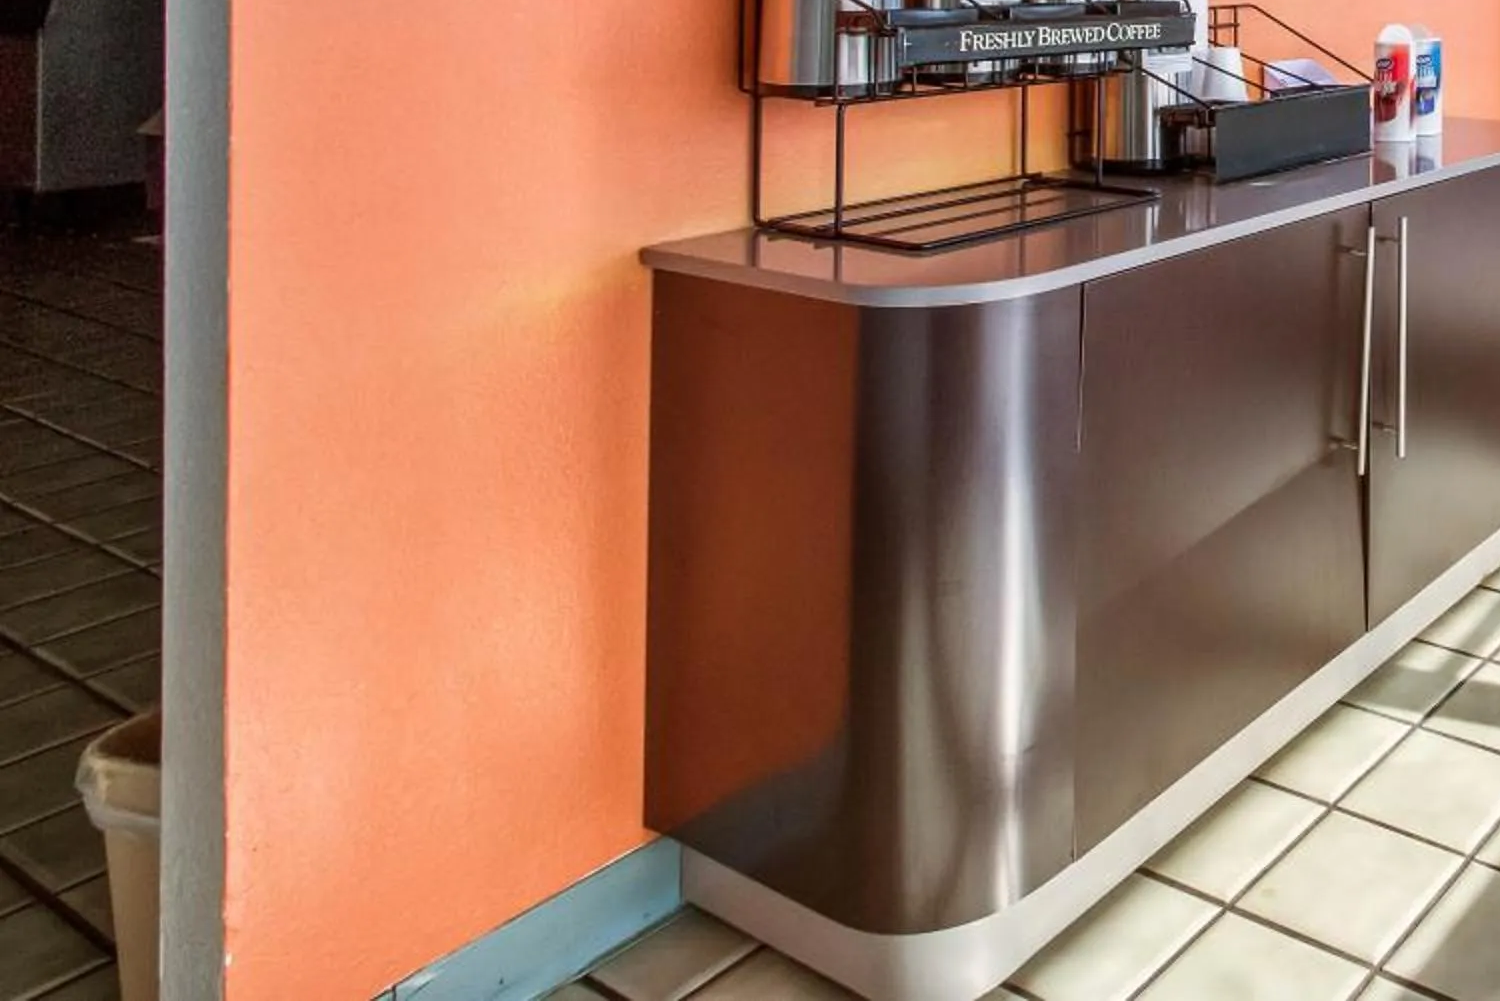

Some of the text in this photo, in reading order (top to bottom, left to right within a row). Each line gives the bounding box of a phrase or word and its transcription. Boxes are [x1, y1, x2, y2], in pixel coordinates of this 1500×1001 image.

[960, 22, 1161, 51] FRESHLY BREWED COFFEE
